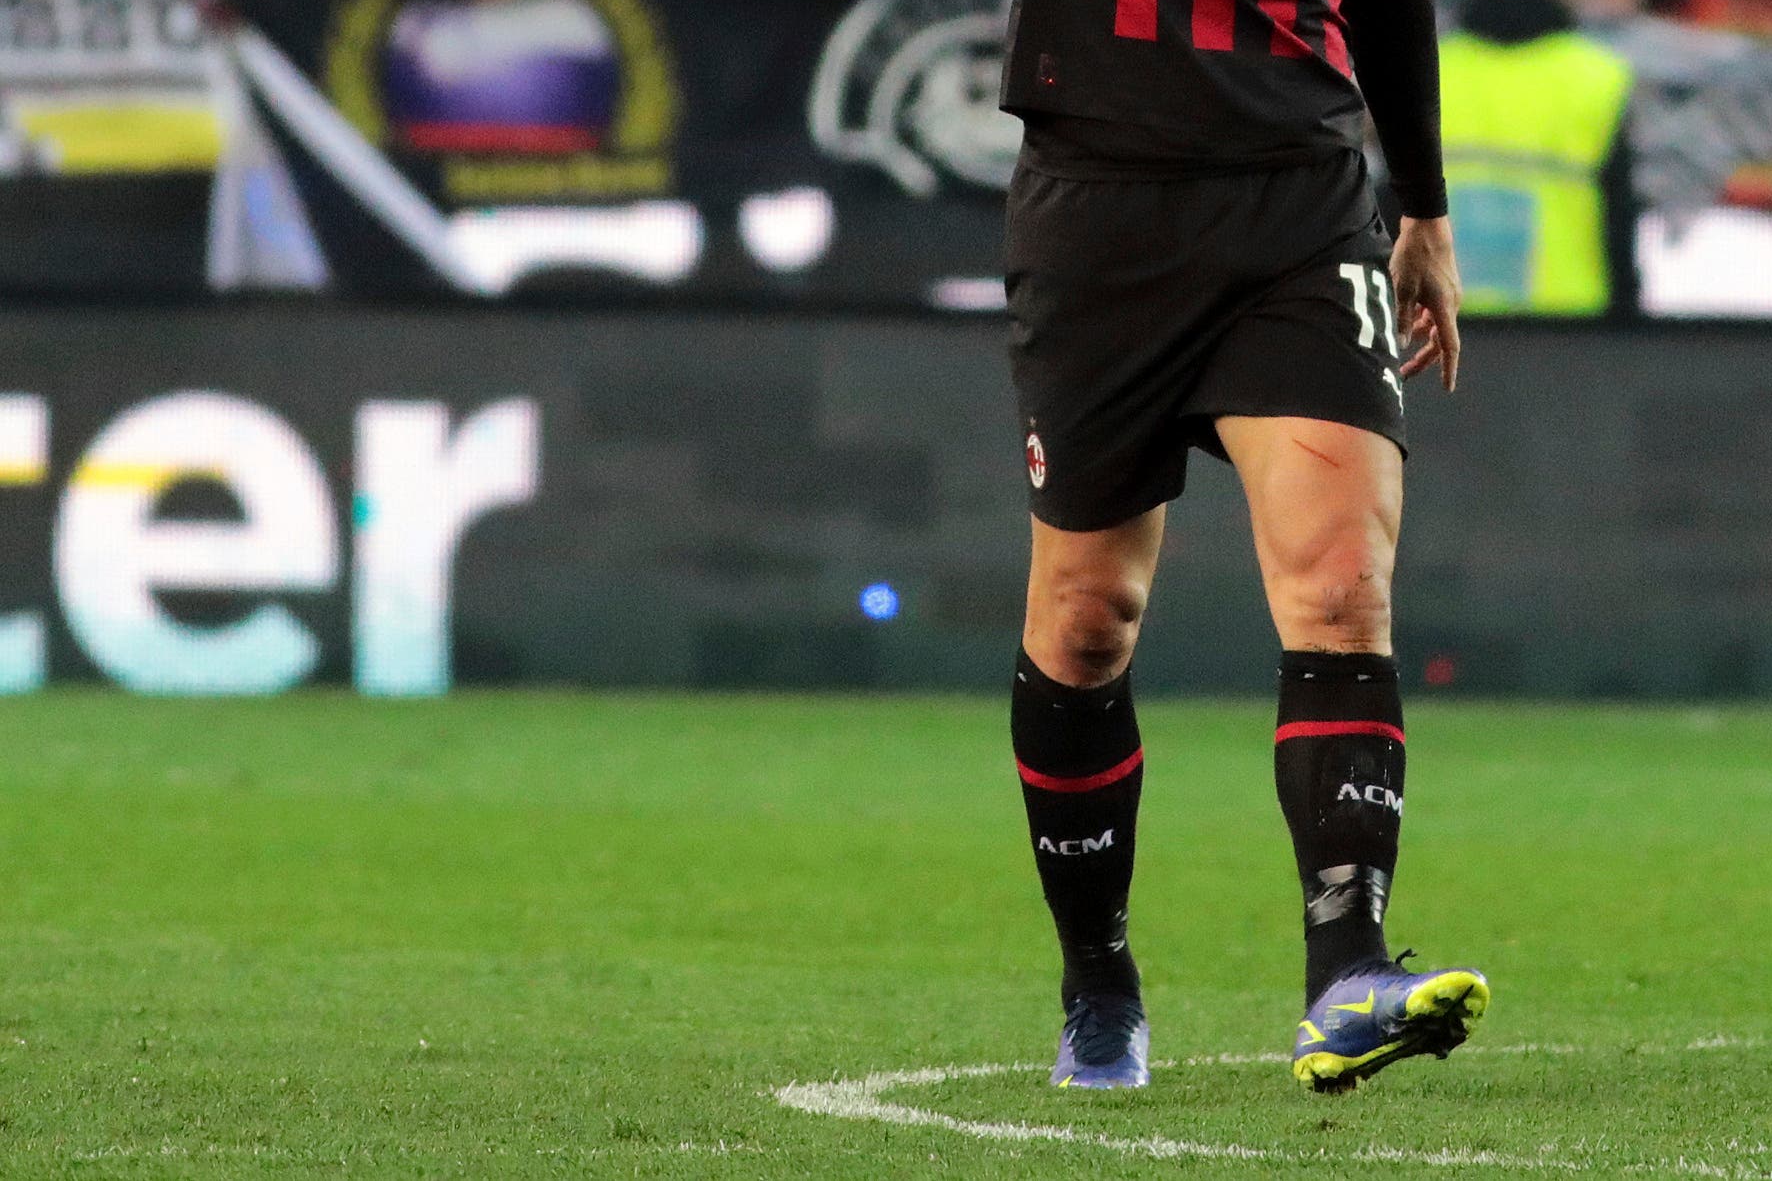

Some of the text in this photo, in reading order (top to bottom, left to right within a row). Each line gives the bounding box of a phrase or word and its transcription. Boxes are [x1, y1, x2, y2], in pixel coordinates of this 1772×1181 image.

[1340, 263, 1399, 358] 11
[1337, 783, 1403, 817] ACM
[1038, 828, 1115, 856] ACM
